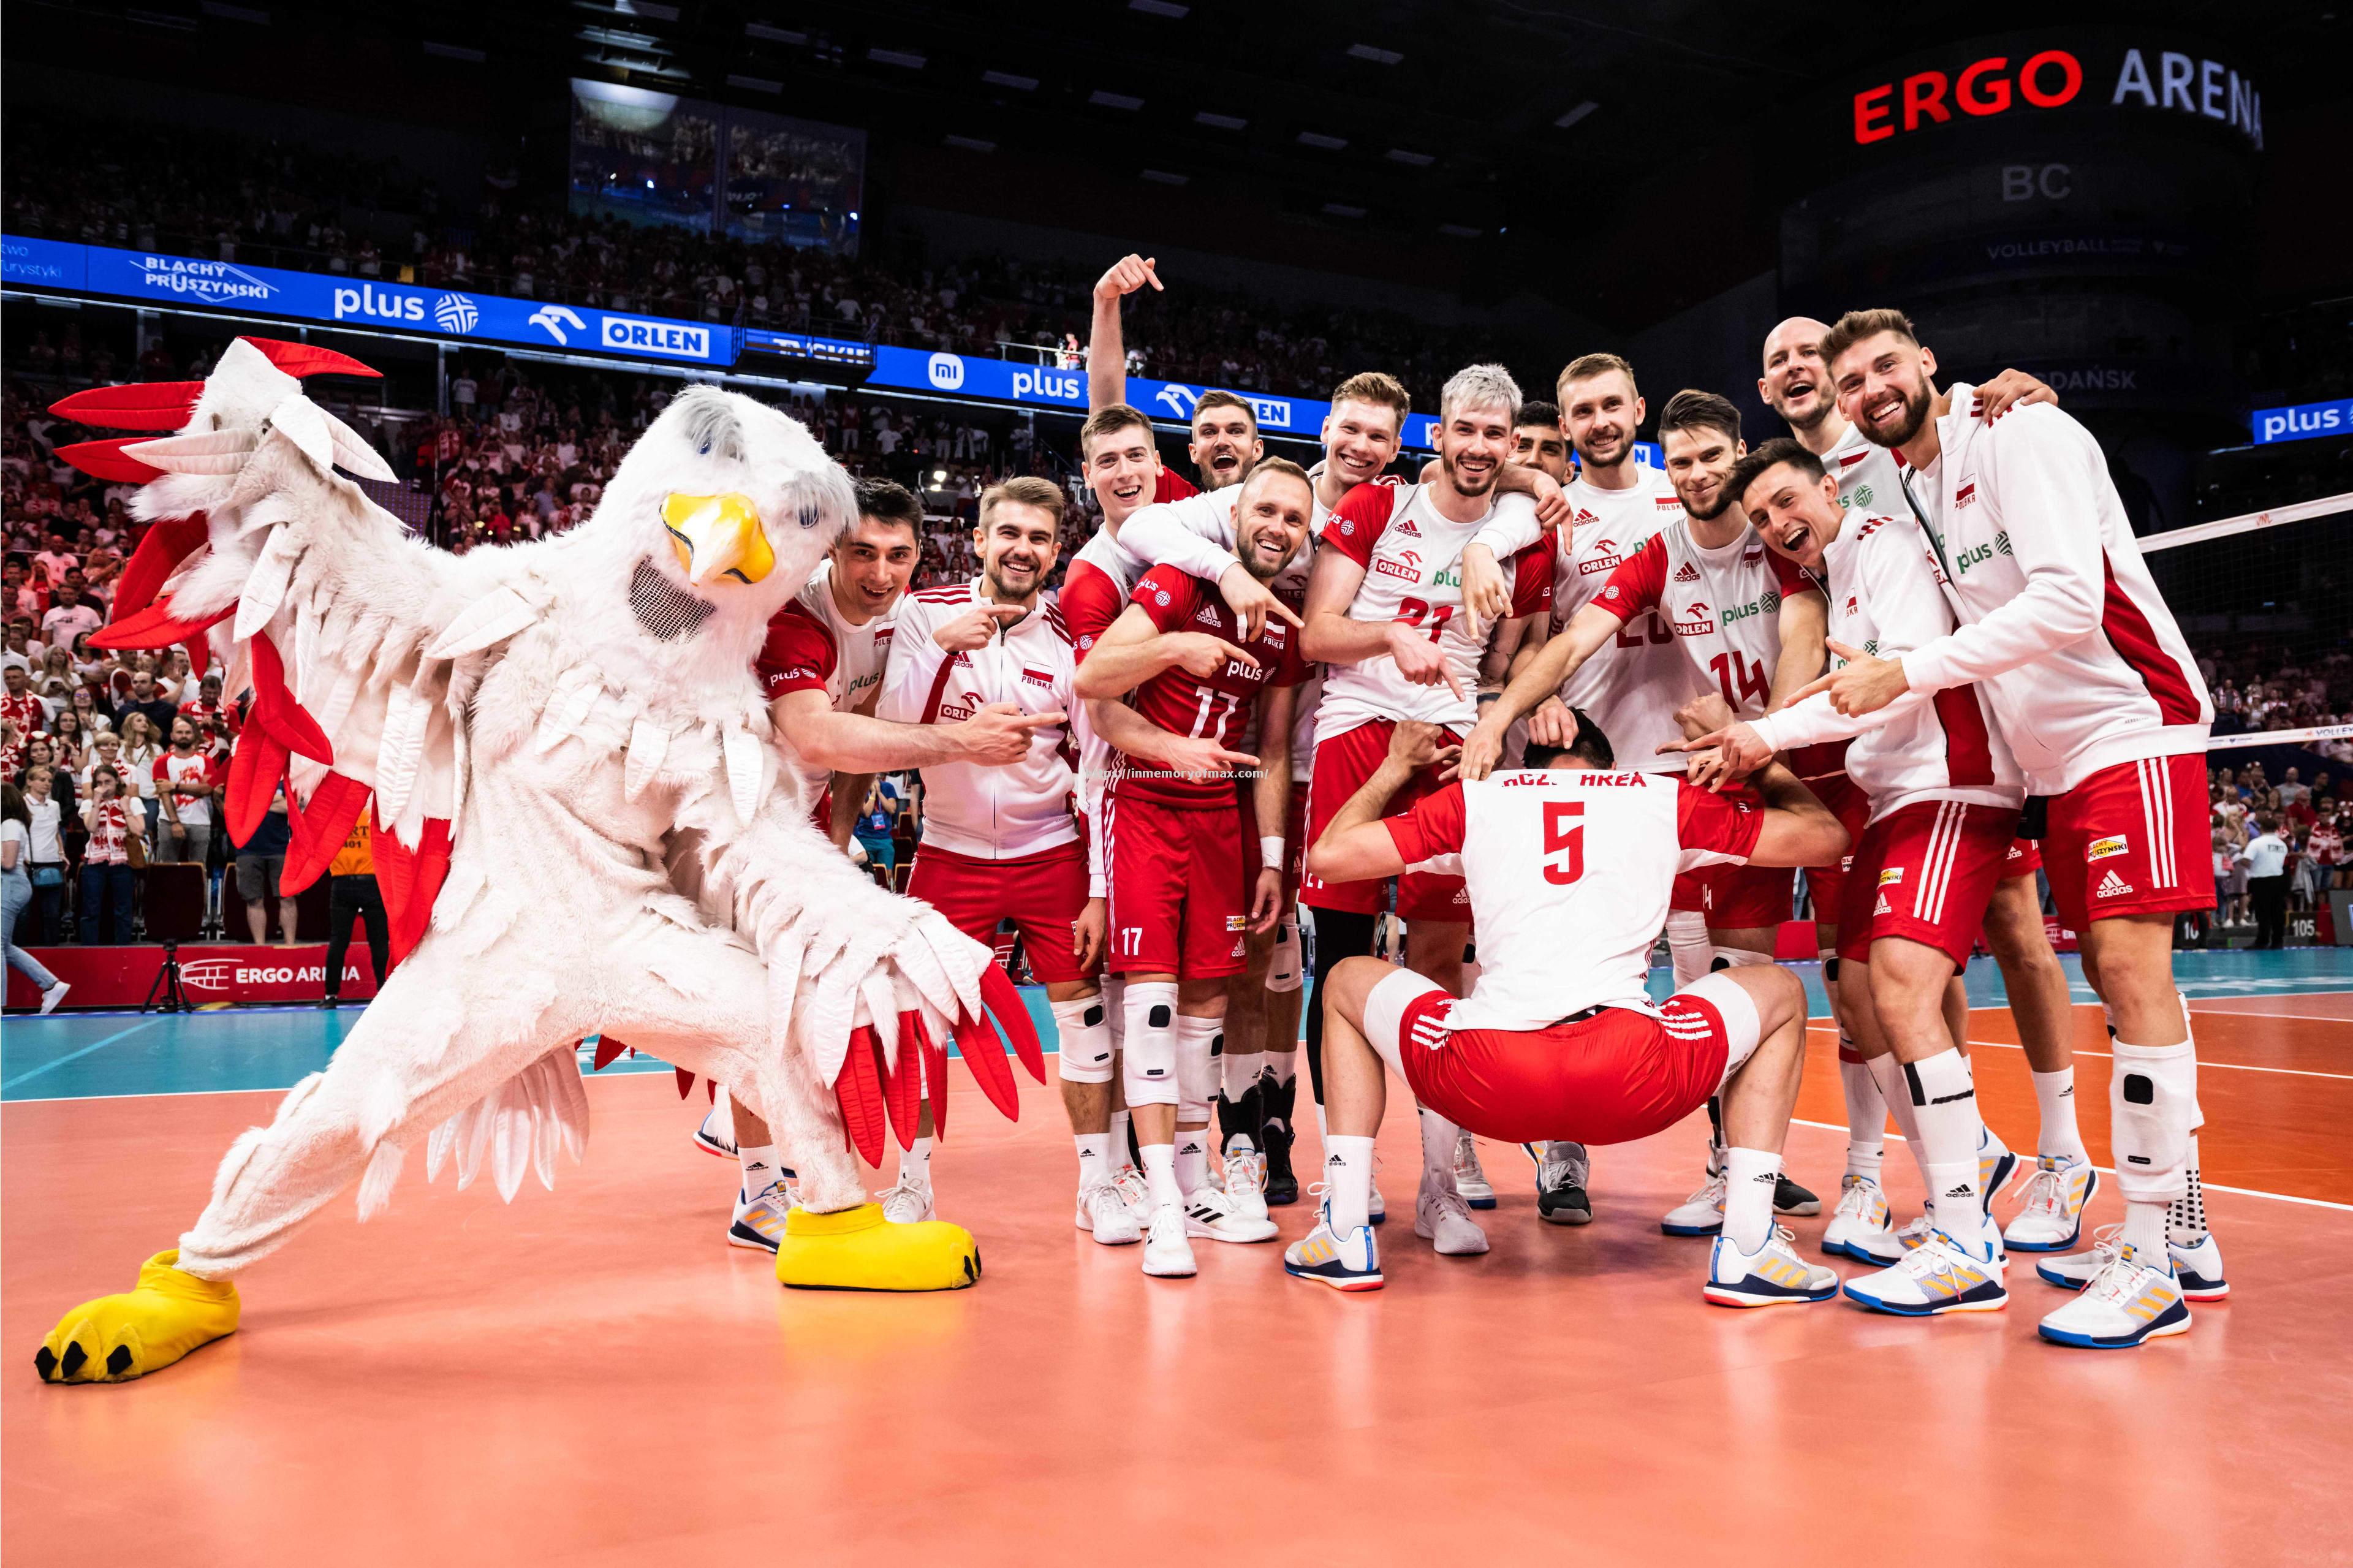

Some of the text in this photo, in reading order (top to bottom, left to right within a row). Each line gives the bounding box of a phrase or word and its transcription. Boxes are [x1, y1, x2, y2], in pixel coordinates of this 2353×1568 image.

[1854, 48, 2264, 150] ERGO ARENA
[2002, 163, 2071, 201] BC
[1987, 239, 2110, 260] VOLLEYBALL
[1, 261, 62, 278] urystyki
[146, 257, 226, 277] BLACHY
[335, 284, 425, 320] plus
[609, 322, 702, 352] ORLEN
[1013, 369, 1080, 400] plus
[2265, 408, 2341, 441] plus
[1573, 515, 1599, 528] adidas
[1395, 526, 1422, 539] adidas
[1581, 556, 1620, 573] ORLEN
[1957, 543, 1993, 574] plus
[1379, 561, 1419, 581] ORLEN
[1433, 570, 1462, 588] plu
[1674, 573, 1700, 582] adidas
[1196, 614, 1222, 628] adidas
[1722, 602, 1759, 626] plus
[1676, 623, 1711, 635] ORLEN
[873, 637, 892, 647] POLS
[1263, 636, 1284, 650] POLKA
[954, 659, 974, 668] didas
[1227, 660, 1263, 681] plus
[770, 667, 800, 687] plus
[848, 672, 880, 695] plus
[1021, 675, 1053, 691] POLSKA
[1710, 650, 1771, 713] 14
[943, 706, 973, 720] ORLE
[1189, 686, 1240, 742] 17
[1542, 801, 1585, 885] 5
[2096, 884, 2134, 899] adidas
[2292, 919, 2315, 937] 105
[1122, 927, 1143, 956] 17
[236, 967, 294, 983] ERGO
